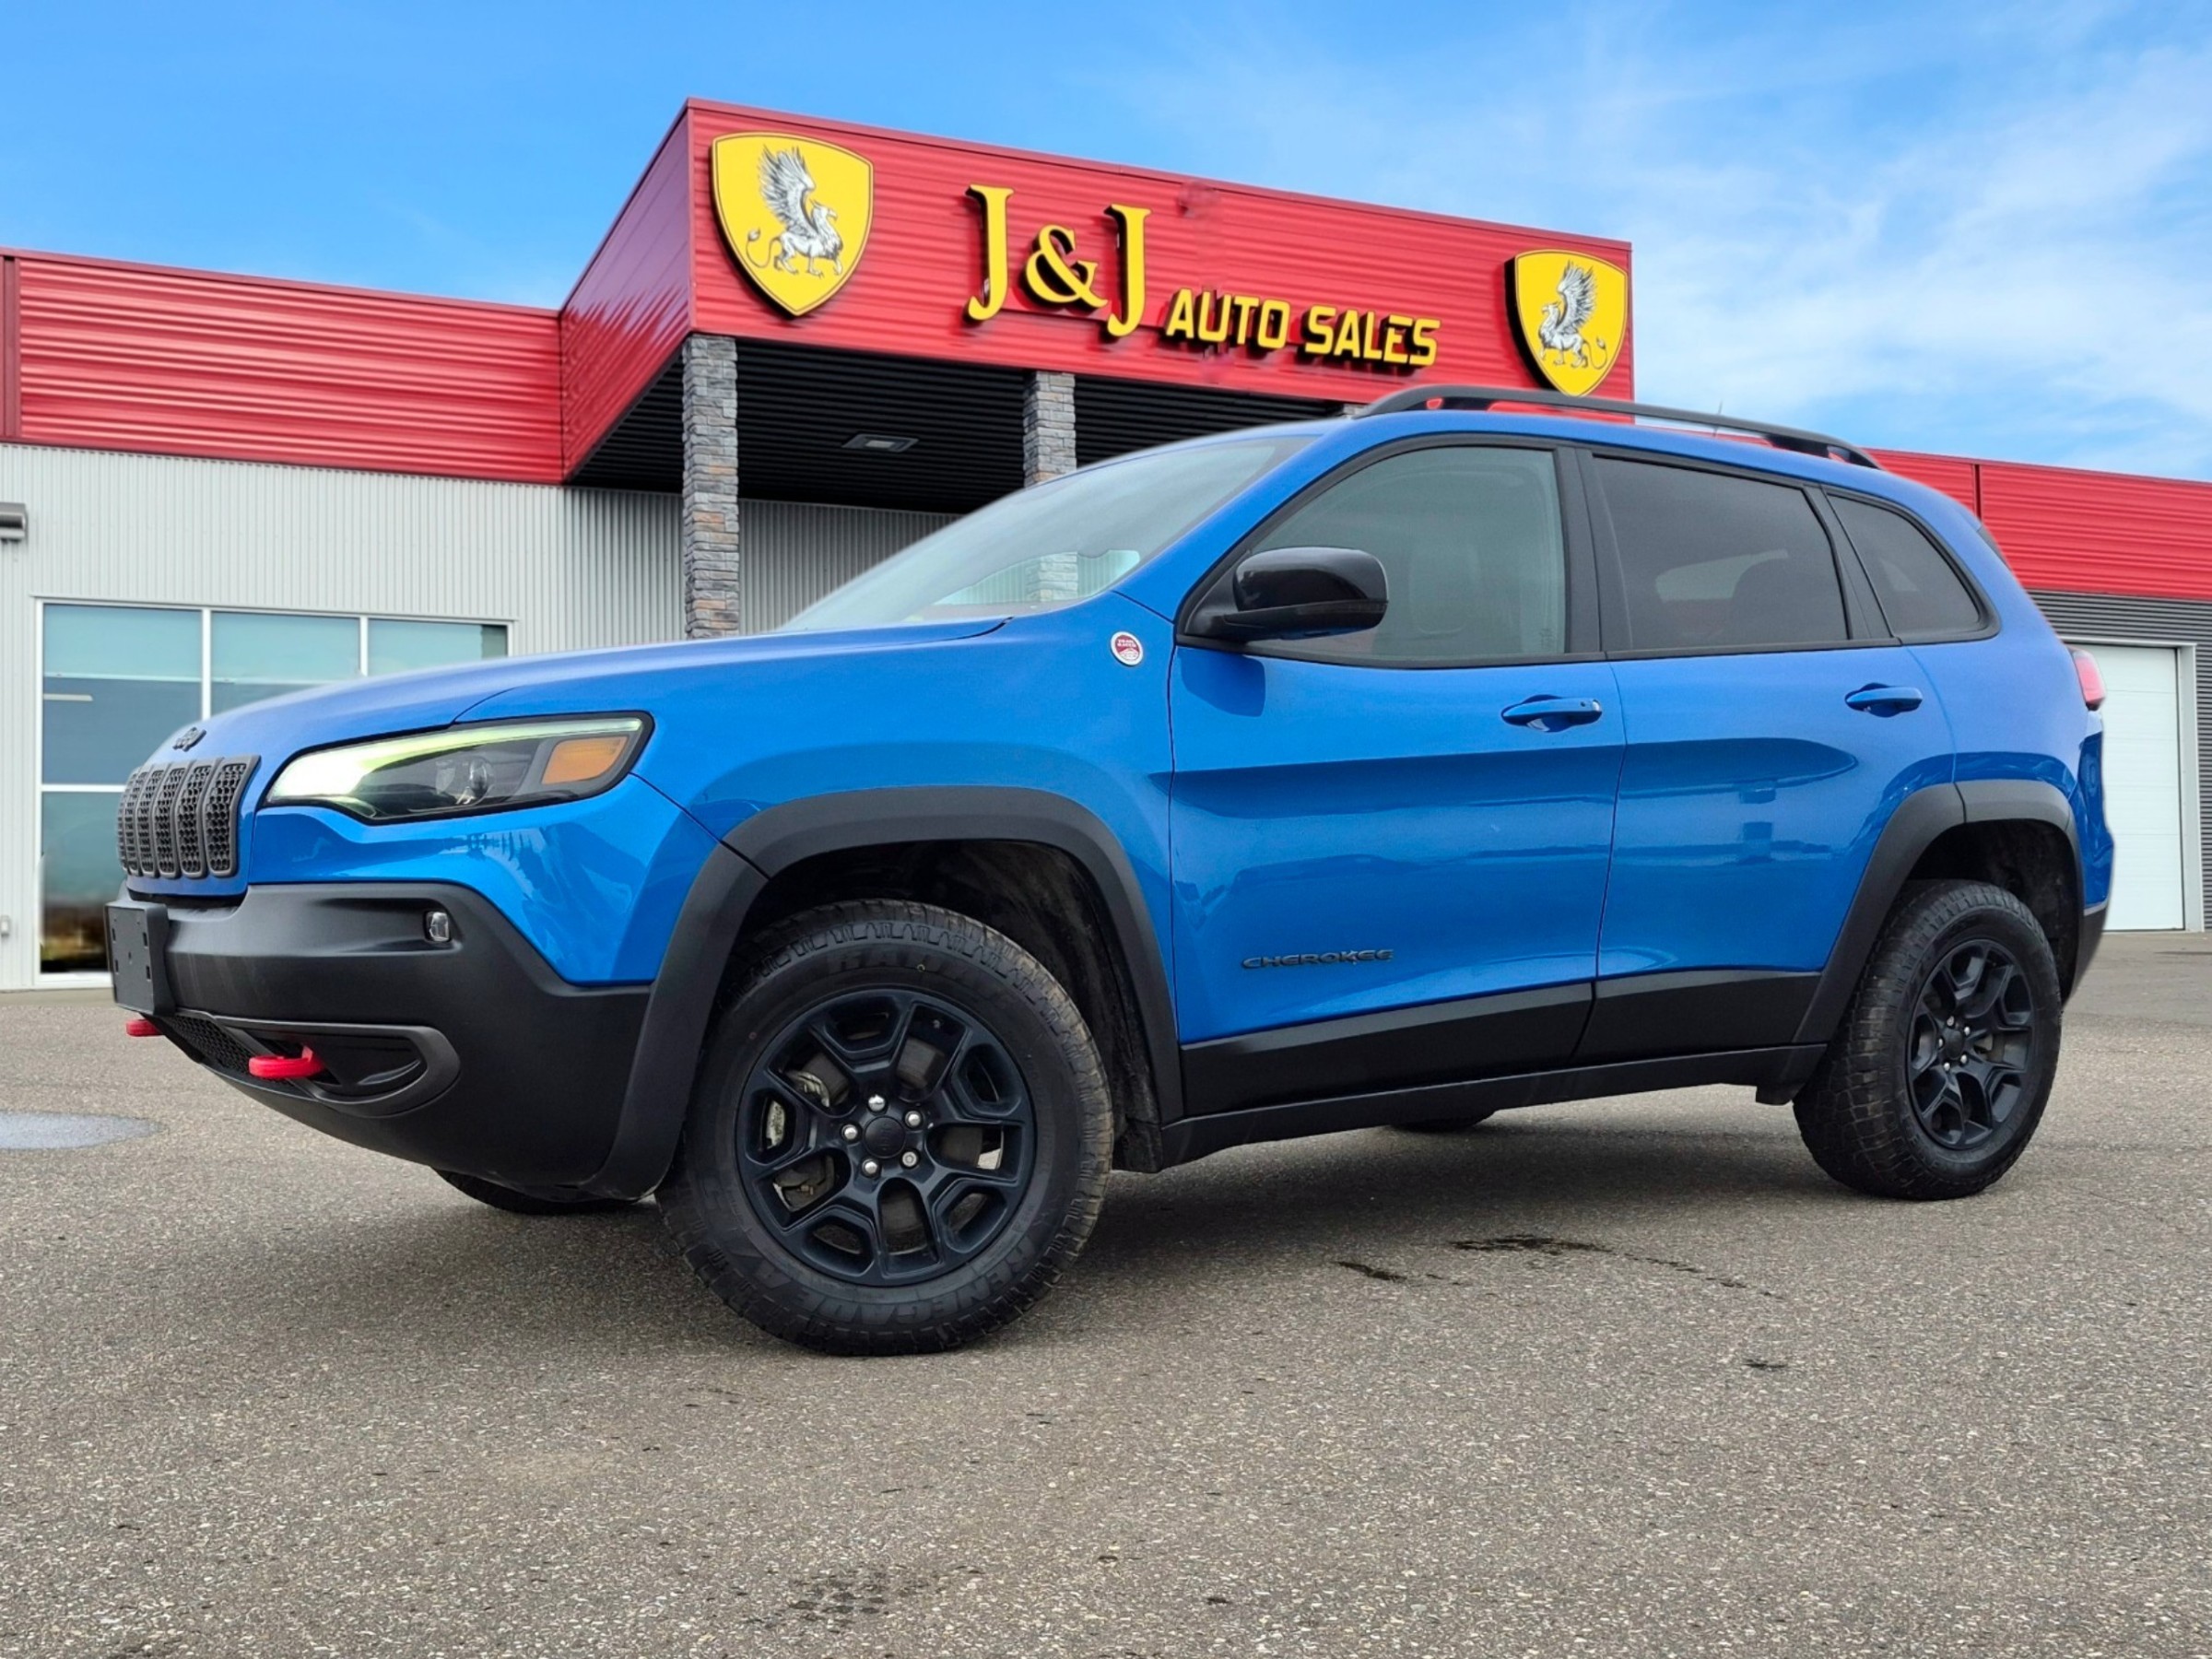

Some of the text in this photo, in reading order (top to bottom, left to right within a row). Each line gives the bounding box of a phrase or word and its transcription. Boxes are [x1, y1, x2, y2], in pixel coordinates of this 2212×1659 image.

[968, 183, 1441, 366] J&J AUTO SALES
[1242, 947, 1394, 969] CHEROKEE
